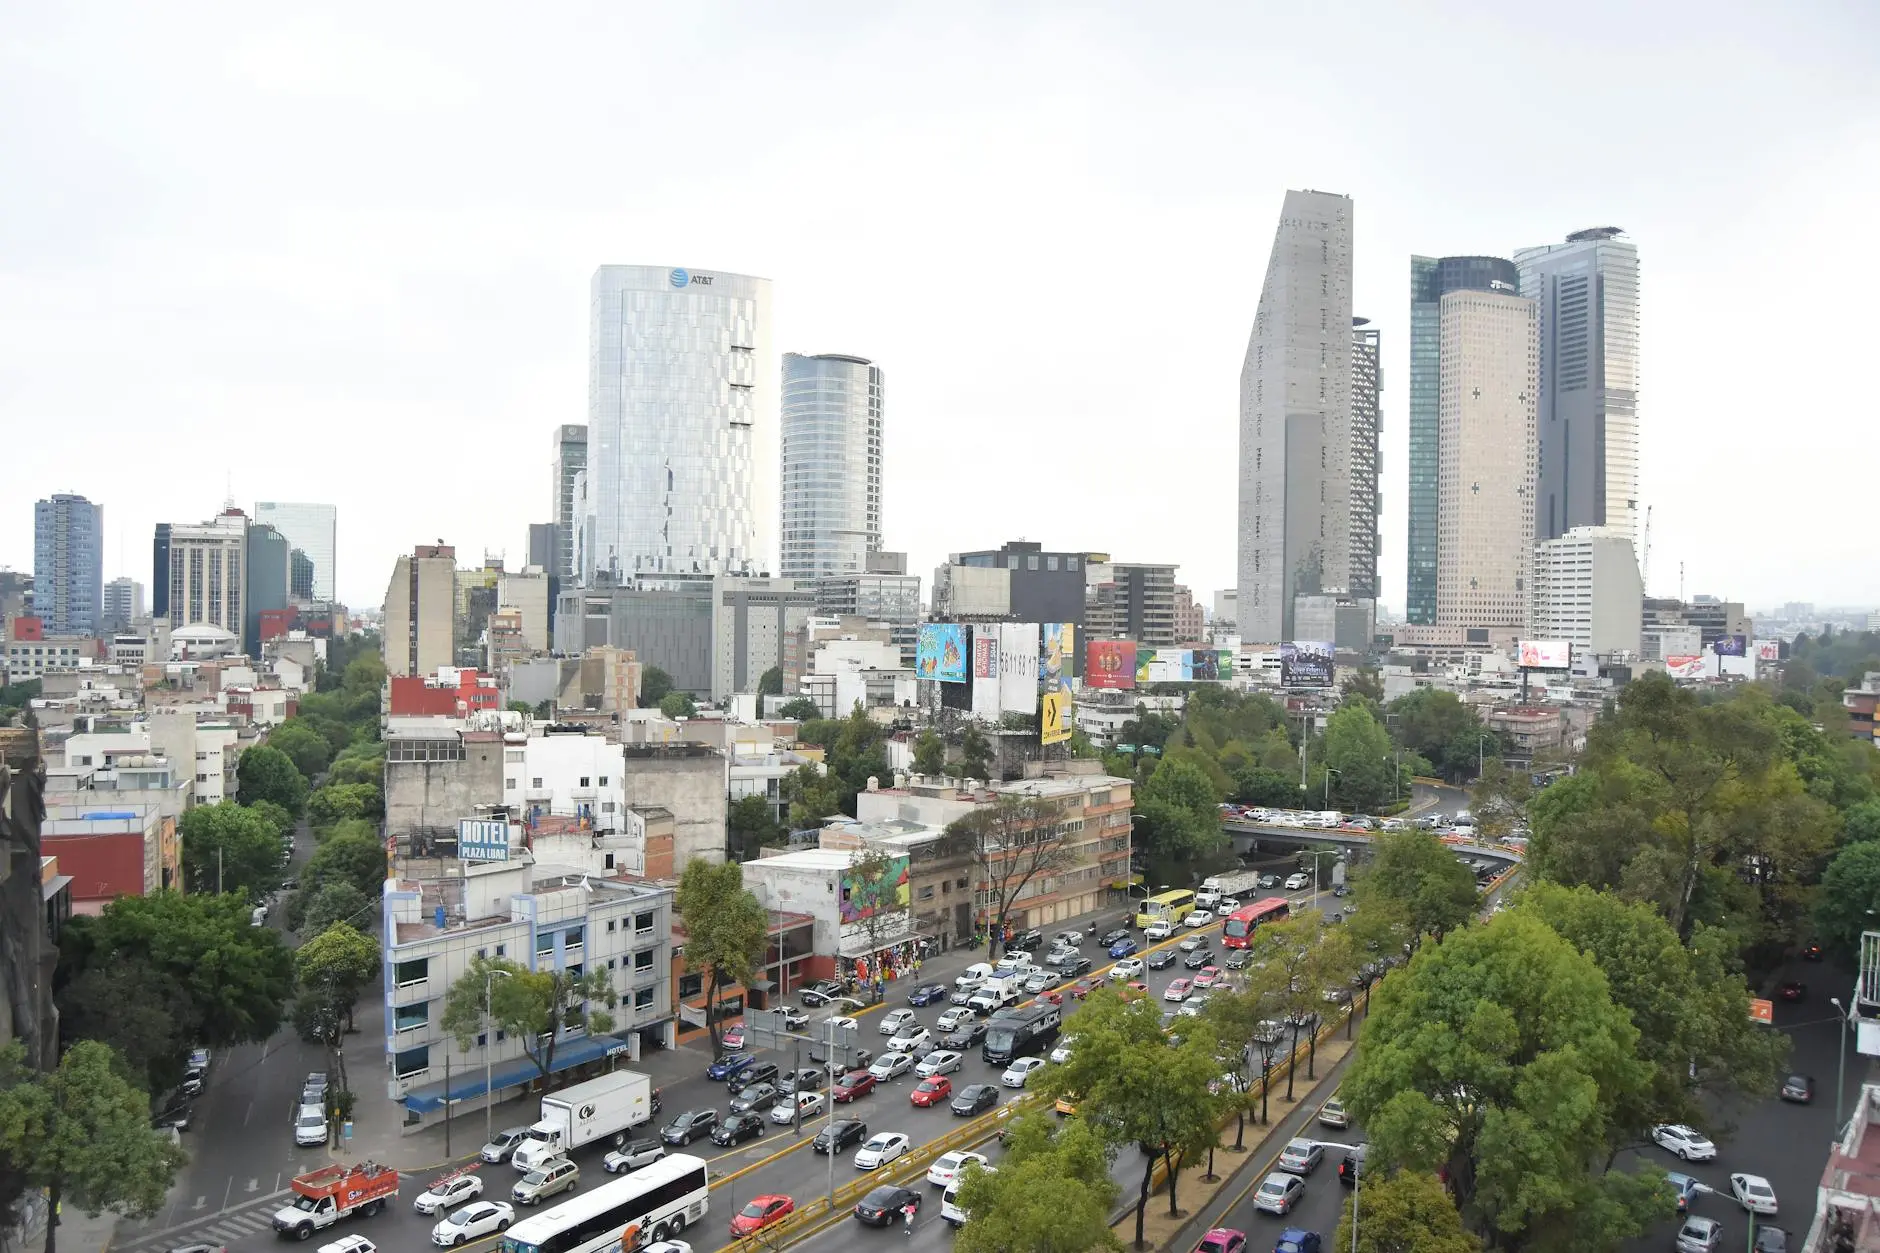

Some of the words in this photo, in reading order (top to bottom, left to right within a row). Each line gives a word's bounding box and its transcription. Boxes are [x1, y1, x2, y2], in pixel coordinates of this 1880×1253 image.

[691, 275, 714, 285] AT&T
[462, 821, 508, 844] HOTEL
[462, 847, 486, 859] PLAZA
[487, 848, 506, 860] LUAR
[1032, 1011, 1060, 1035] BLACK
[606, 1044, 628, 1056] HOTEL
